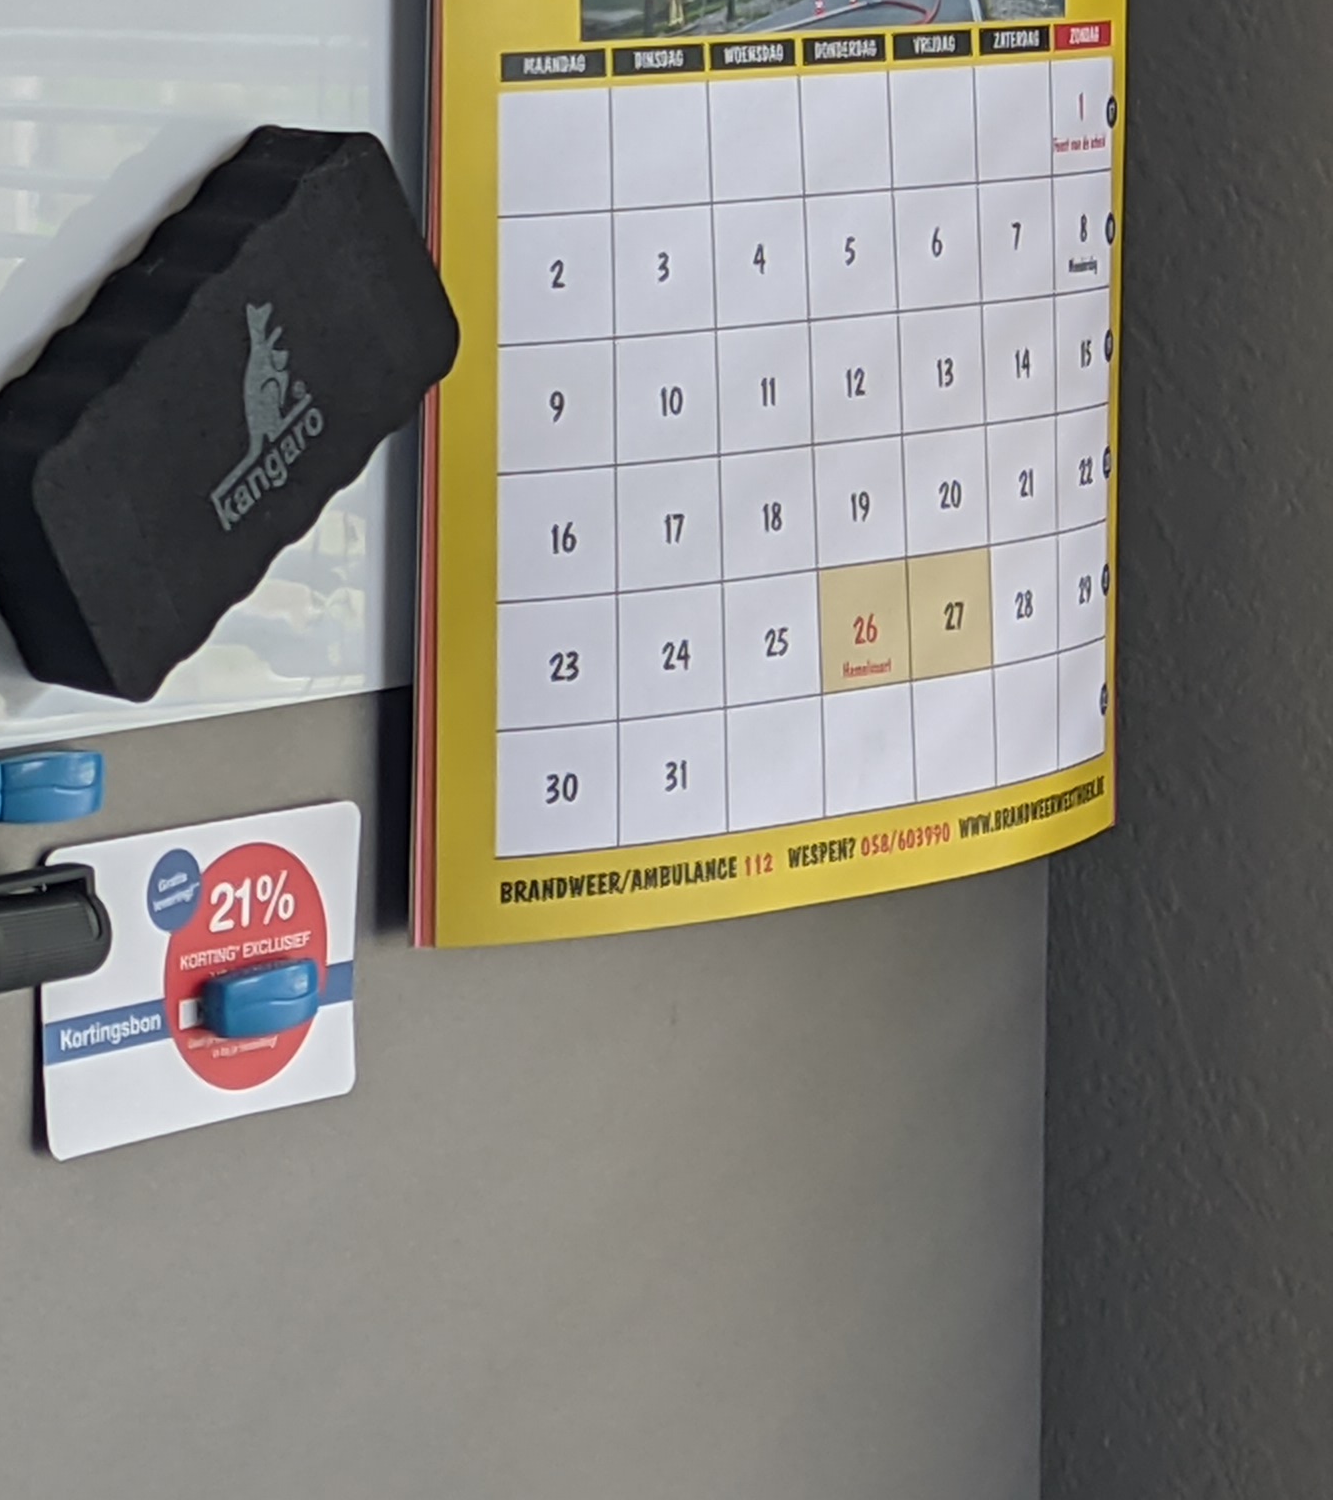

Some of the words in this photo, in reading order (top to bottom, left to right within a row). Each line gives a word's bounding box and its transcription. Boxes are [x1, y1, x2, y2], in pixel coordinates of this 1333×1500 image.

[523, 53, 586, 75] MAANDAG
[634, 49, 684, 70] DINSDAG
[724, 43, 784, 65] WOENSDAG
[814, 38, 878, 60] DONDERDAG
[913, 34, 956, 54] VRIJDAG
[993, 30, 1040, 49] ZATERDAG
[1069, 25, 1099, 44] ZONDAG
[1078, 91, 1085, 122] 1
[550, 260, 565, 289] 2
[658, 252, 670, 282] 3
[753, 244, 766, 275] 4
[844, 236, 856, 266] 5
[932, 226, 943, 257] 6
[1011, 221, 1022, 250] 7
[1079, 213, 1088, 243] 8
[549, 390, 565, 422] 9
[660, 386, 683, 416] 10
[761, 377, 776, 407] 11
[845, 368, 866, 398] 12
[937, 357, 954, 388] 13
[1015, 347, 1031, 379] 14
[1080, 339, 1092, 369] 15
[211, 407, 323, 531] kangaro
[551, 522, 577, 554] 16
[665, 514, 685, 544] 17
[762, 502, 782, 532] 18
[851, 491, 870, 523] 19
[939, 480, 962, 510] 20
[1019, 468, 1034, 498] 21
[1078, 456, 1093, 487] 22
[549, 651, 579, 682] 23
[662, 639, 691, 671] 24
[764, 627, 788, 658] 25
[853, 613, 878, 645] 26
[944, 601, 964, 631] 27
[1015, 590, 1033, 619] 28
[1078, 574, 1092, 605] 29
[545, 772, 578, 804] 30
[665, 760, 688, 792] 31
[500, 855, 738, 904] BRANDWEER/AMBULANCE
[744, 852, 773, 877] 112
[788, 837, 856, 869] WESPEN?
[861, 821, 951, 857] 058/603990
[208, 869, 295, 933] 21%
[242, 930, 312, 959] EXCLUSIEF
[59, 1013, 162, 1052] Kortingsbon
